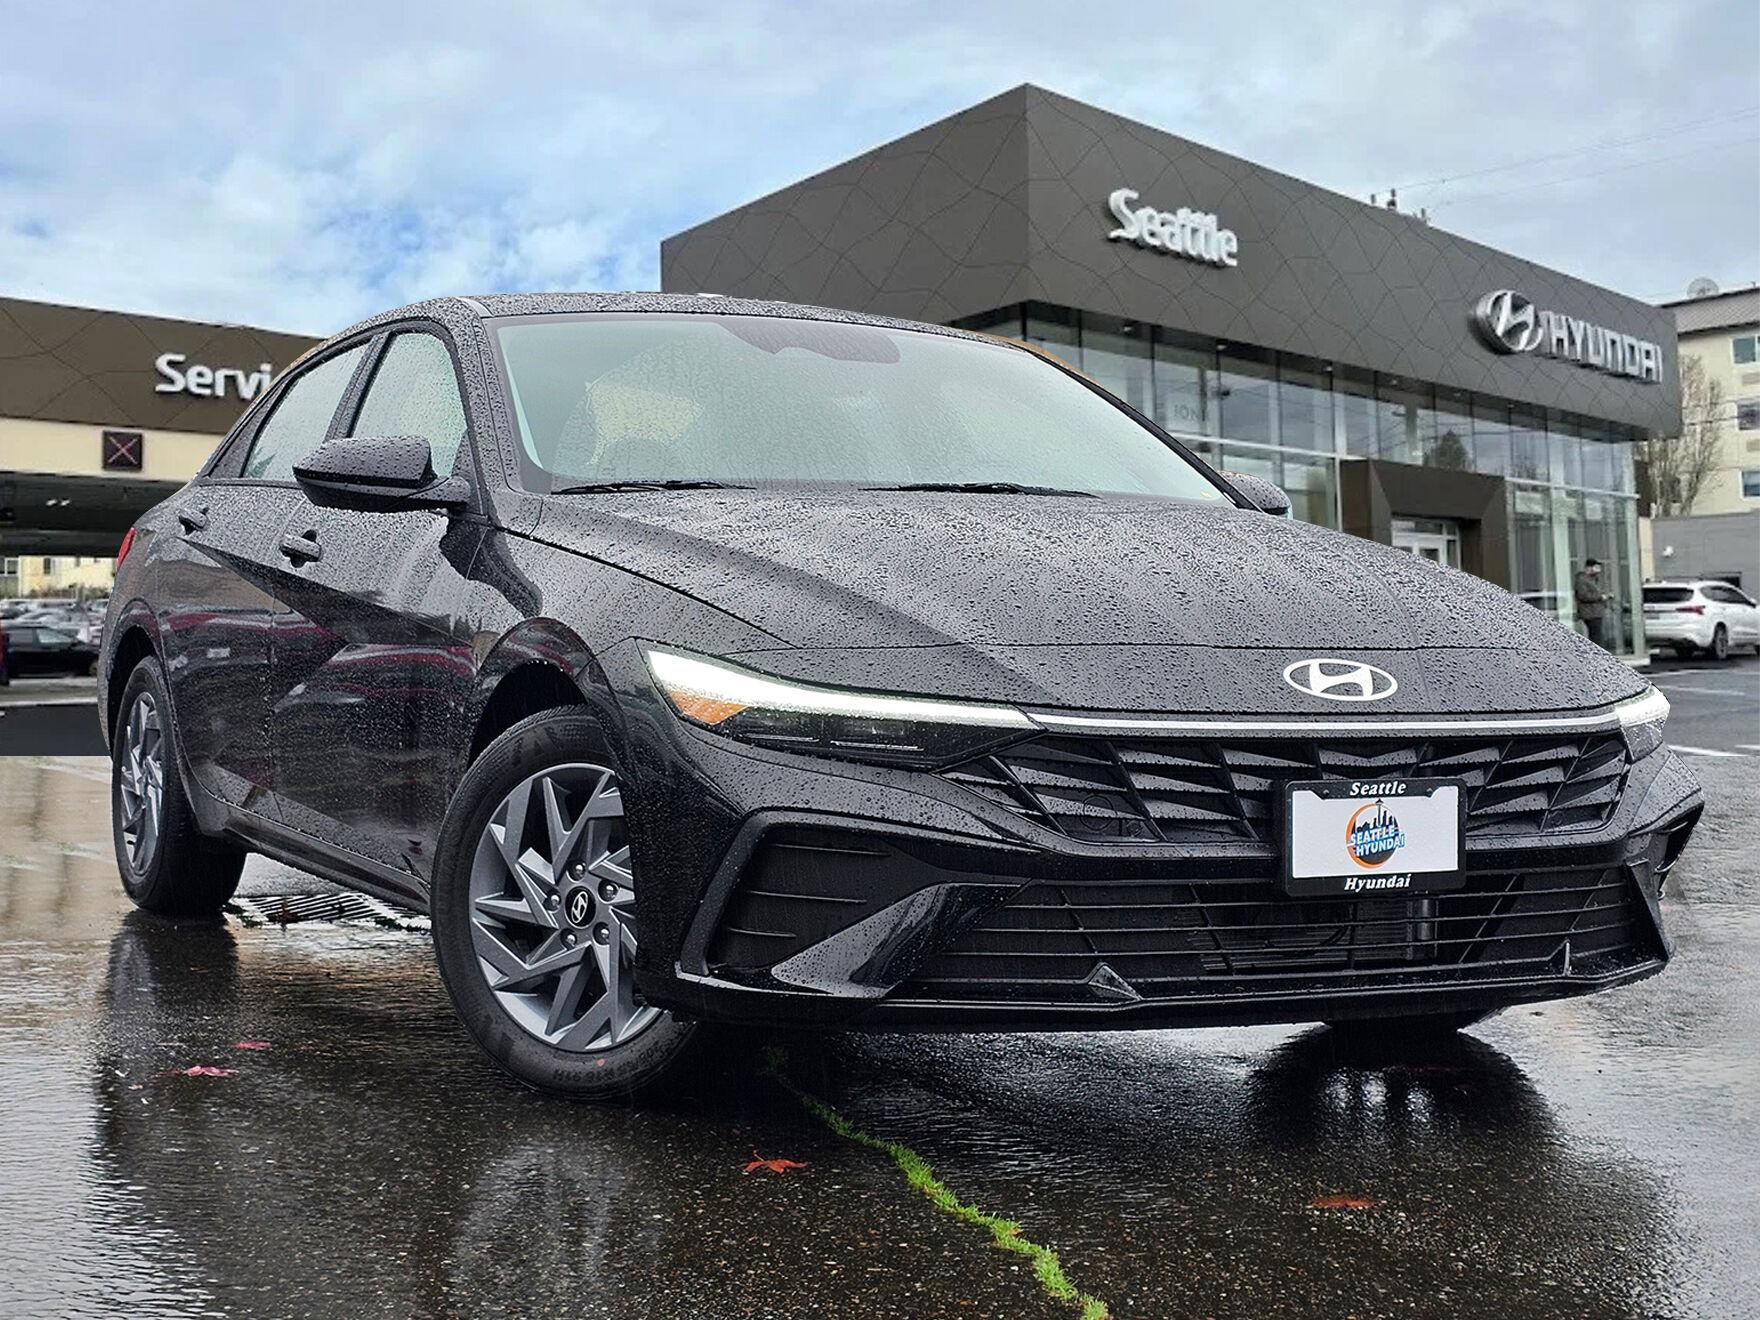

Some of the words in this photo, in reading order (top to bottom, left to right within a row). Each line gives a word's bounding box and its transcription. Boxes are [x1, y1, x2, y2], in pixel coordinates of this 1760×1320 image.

[1108, 186, 1238, 267] Seattle
[1543, 311, 1663, 382] HYUNDAI
[155, 352, 272, 400] Servi
[1350, 781, 1407, 796] Seattle
[1350, 825, 1396, 846] SEATTLE
[1356, 833, 1405, 857] HYUNDAI
[1344, 874, 1412, 892] Hyundai
